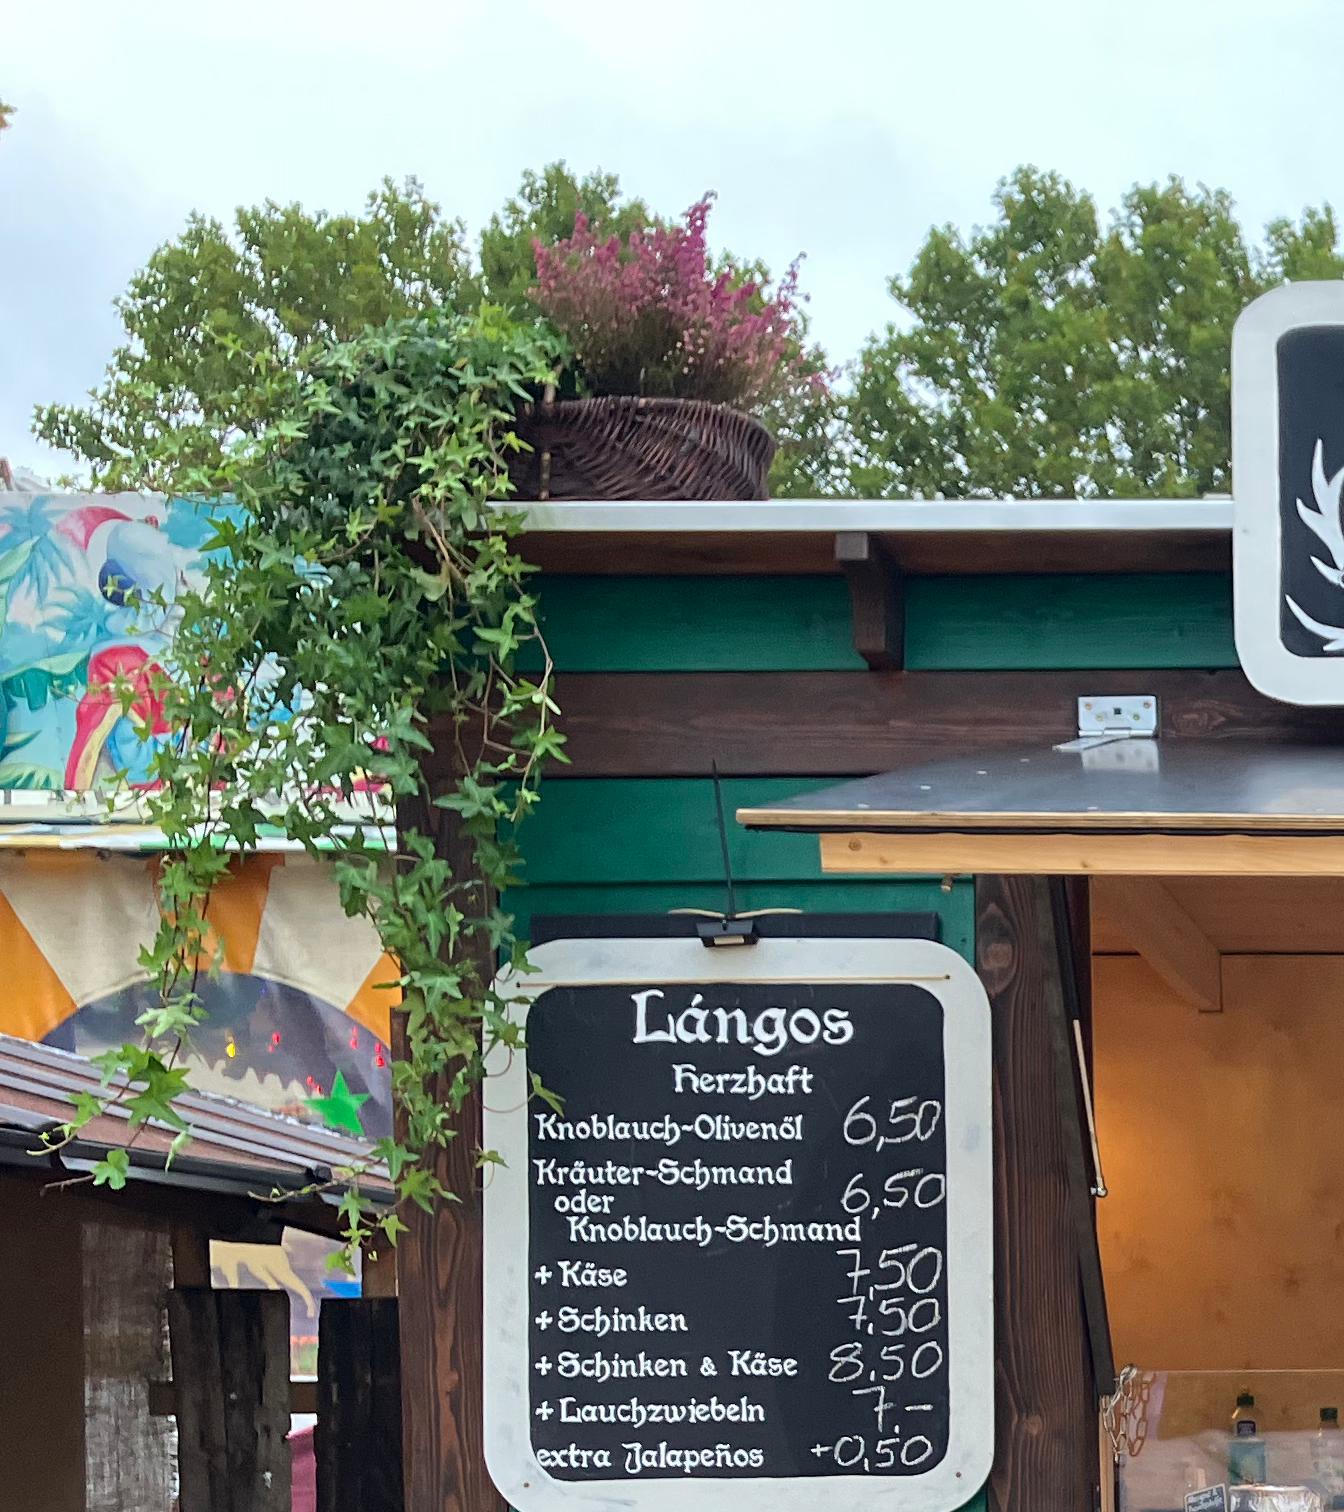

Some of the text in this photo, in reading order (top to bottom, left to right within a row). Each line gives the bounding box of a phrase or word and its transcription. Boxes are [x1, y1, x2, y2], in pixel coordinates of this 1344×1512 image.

[631, 989, 854, 1056] Lángos
[673, 1065, 813, 1099] Herzhaft
[535, 1096, 941, 1151] Knoblauch-Olivenöl 6,50
[533, 1160, 945, 1218] Kräuter-Schmand 6,50
[554, 1191, 614, 1214] oder
[569, 1216, 861, 1246] Knoblauch-Schmand
[558, 1261, 627, 1288] Käse
[836, 1245, 942, 1300] 7,50
[700, 1356, 717, 1376] &
[730, 1351, 798, 1377] Käse
[536, 1436, 932, 1474] extra Jalapeños +0,50
